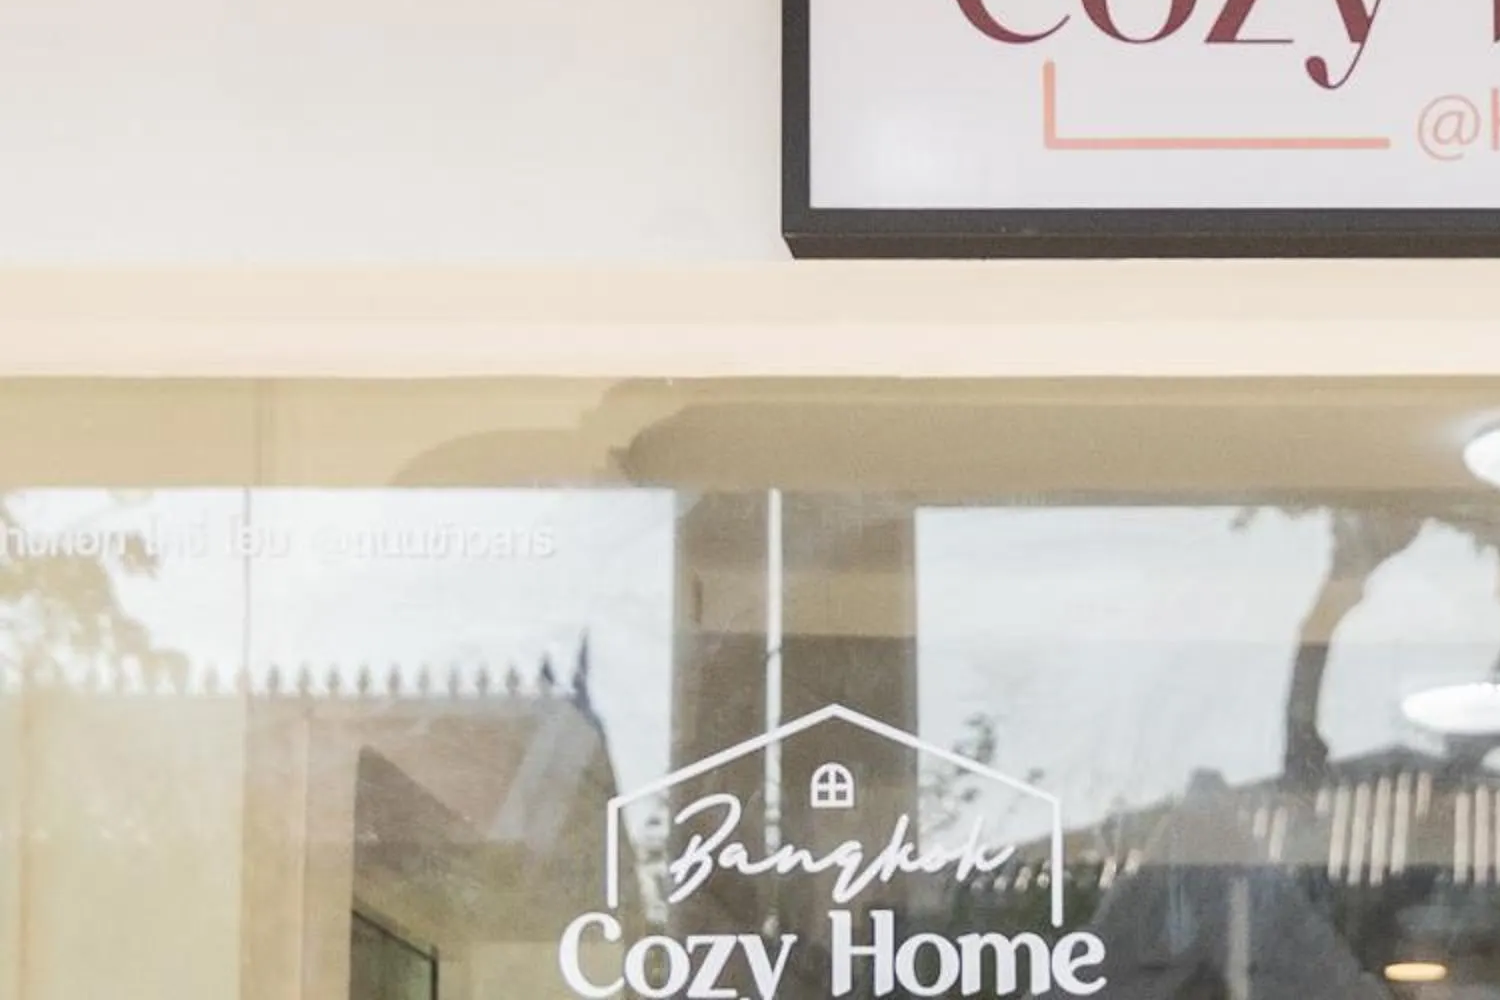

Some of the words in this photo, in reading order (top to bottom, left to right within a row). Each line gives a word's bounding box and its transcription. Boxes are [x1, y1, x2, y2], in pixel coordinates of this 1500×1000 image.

[0, 527, 126, 558] างกอก
[667, 792, 1016, 904] Bangkok
[557, 910, 798, 1000] Cozy
[827, 908, 1107, 999] Home
